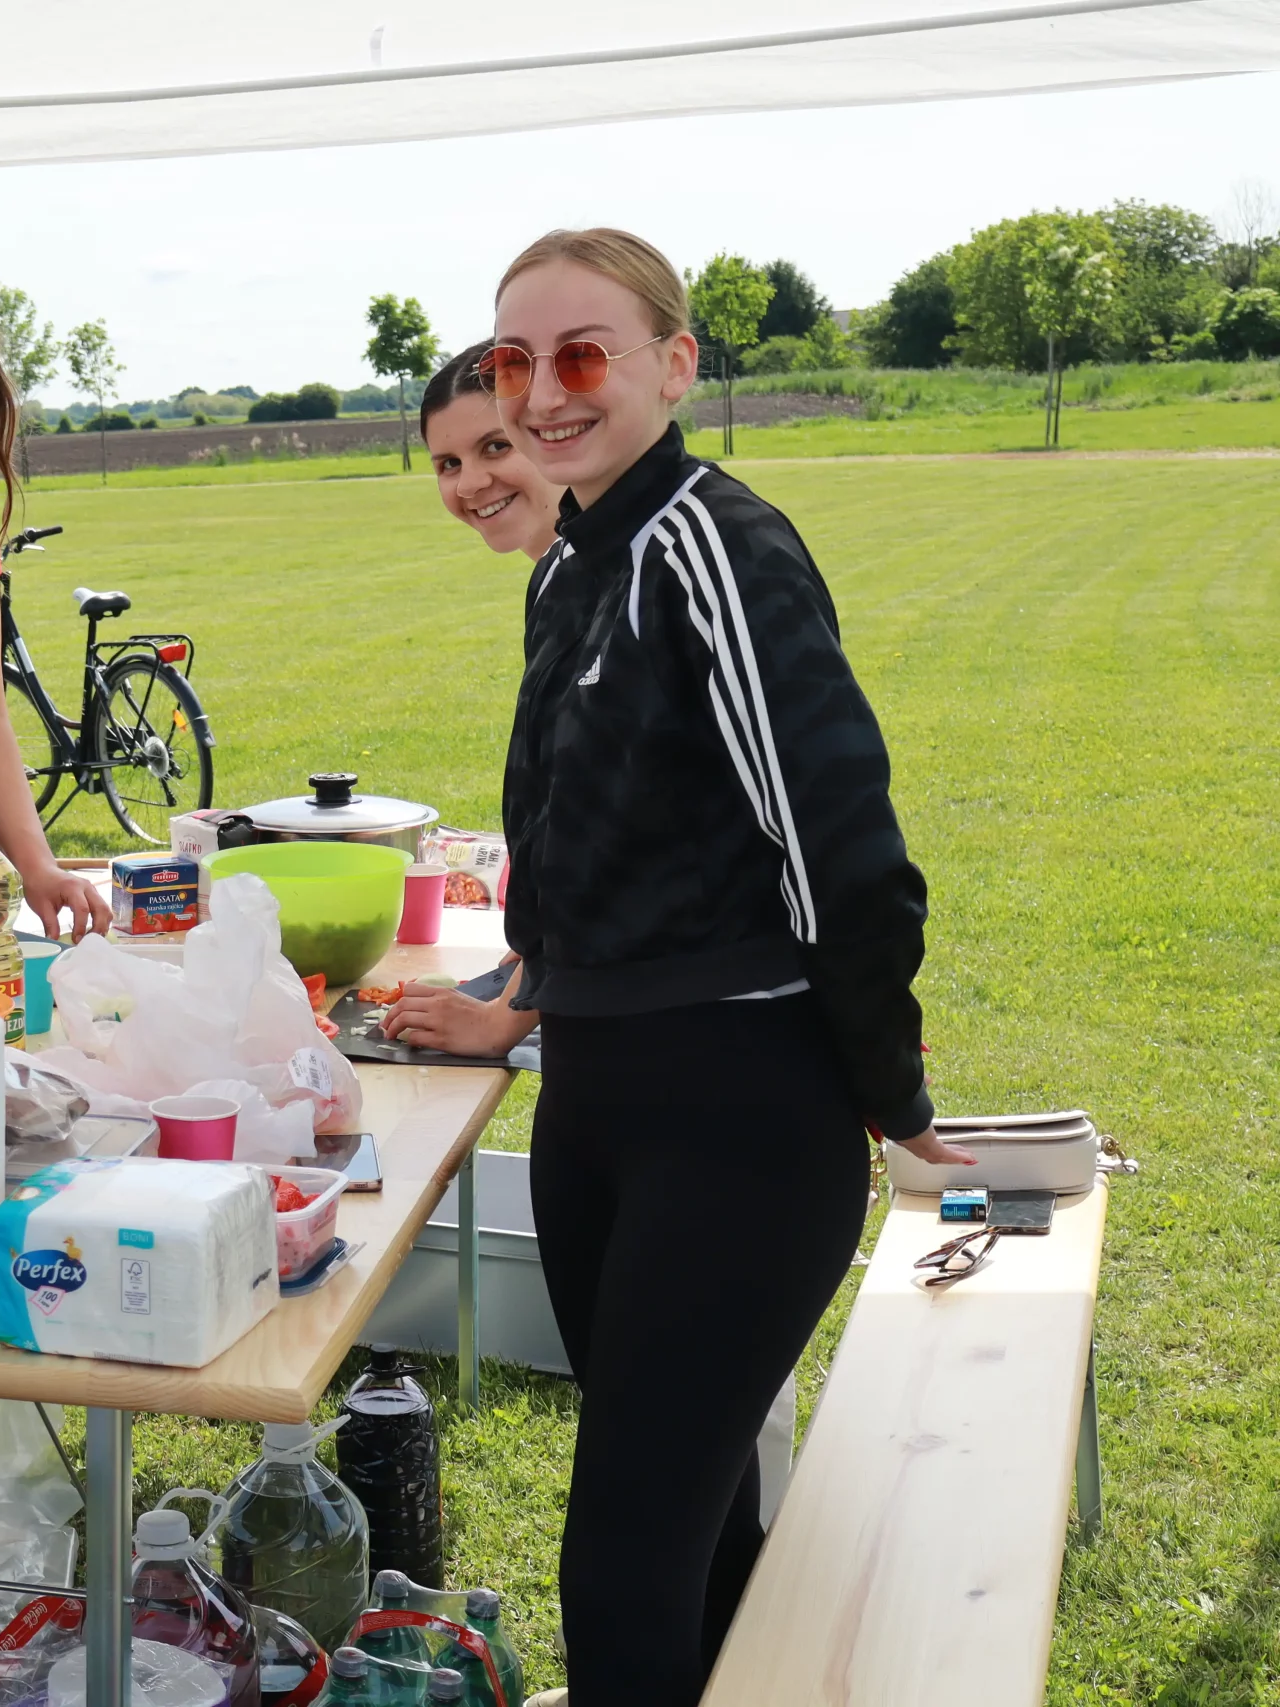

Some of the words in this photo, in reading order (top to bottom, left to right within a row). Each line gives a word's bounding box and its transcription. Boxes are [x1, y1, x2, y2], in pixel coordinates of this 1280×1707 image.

[149, 894, 180, 904] PASSATA
[123, 1231, 149, 1243] BONI
[16, 1258, 84, 1284] Perfex
[41, 1290, 58, 1302] 100
